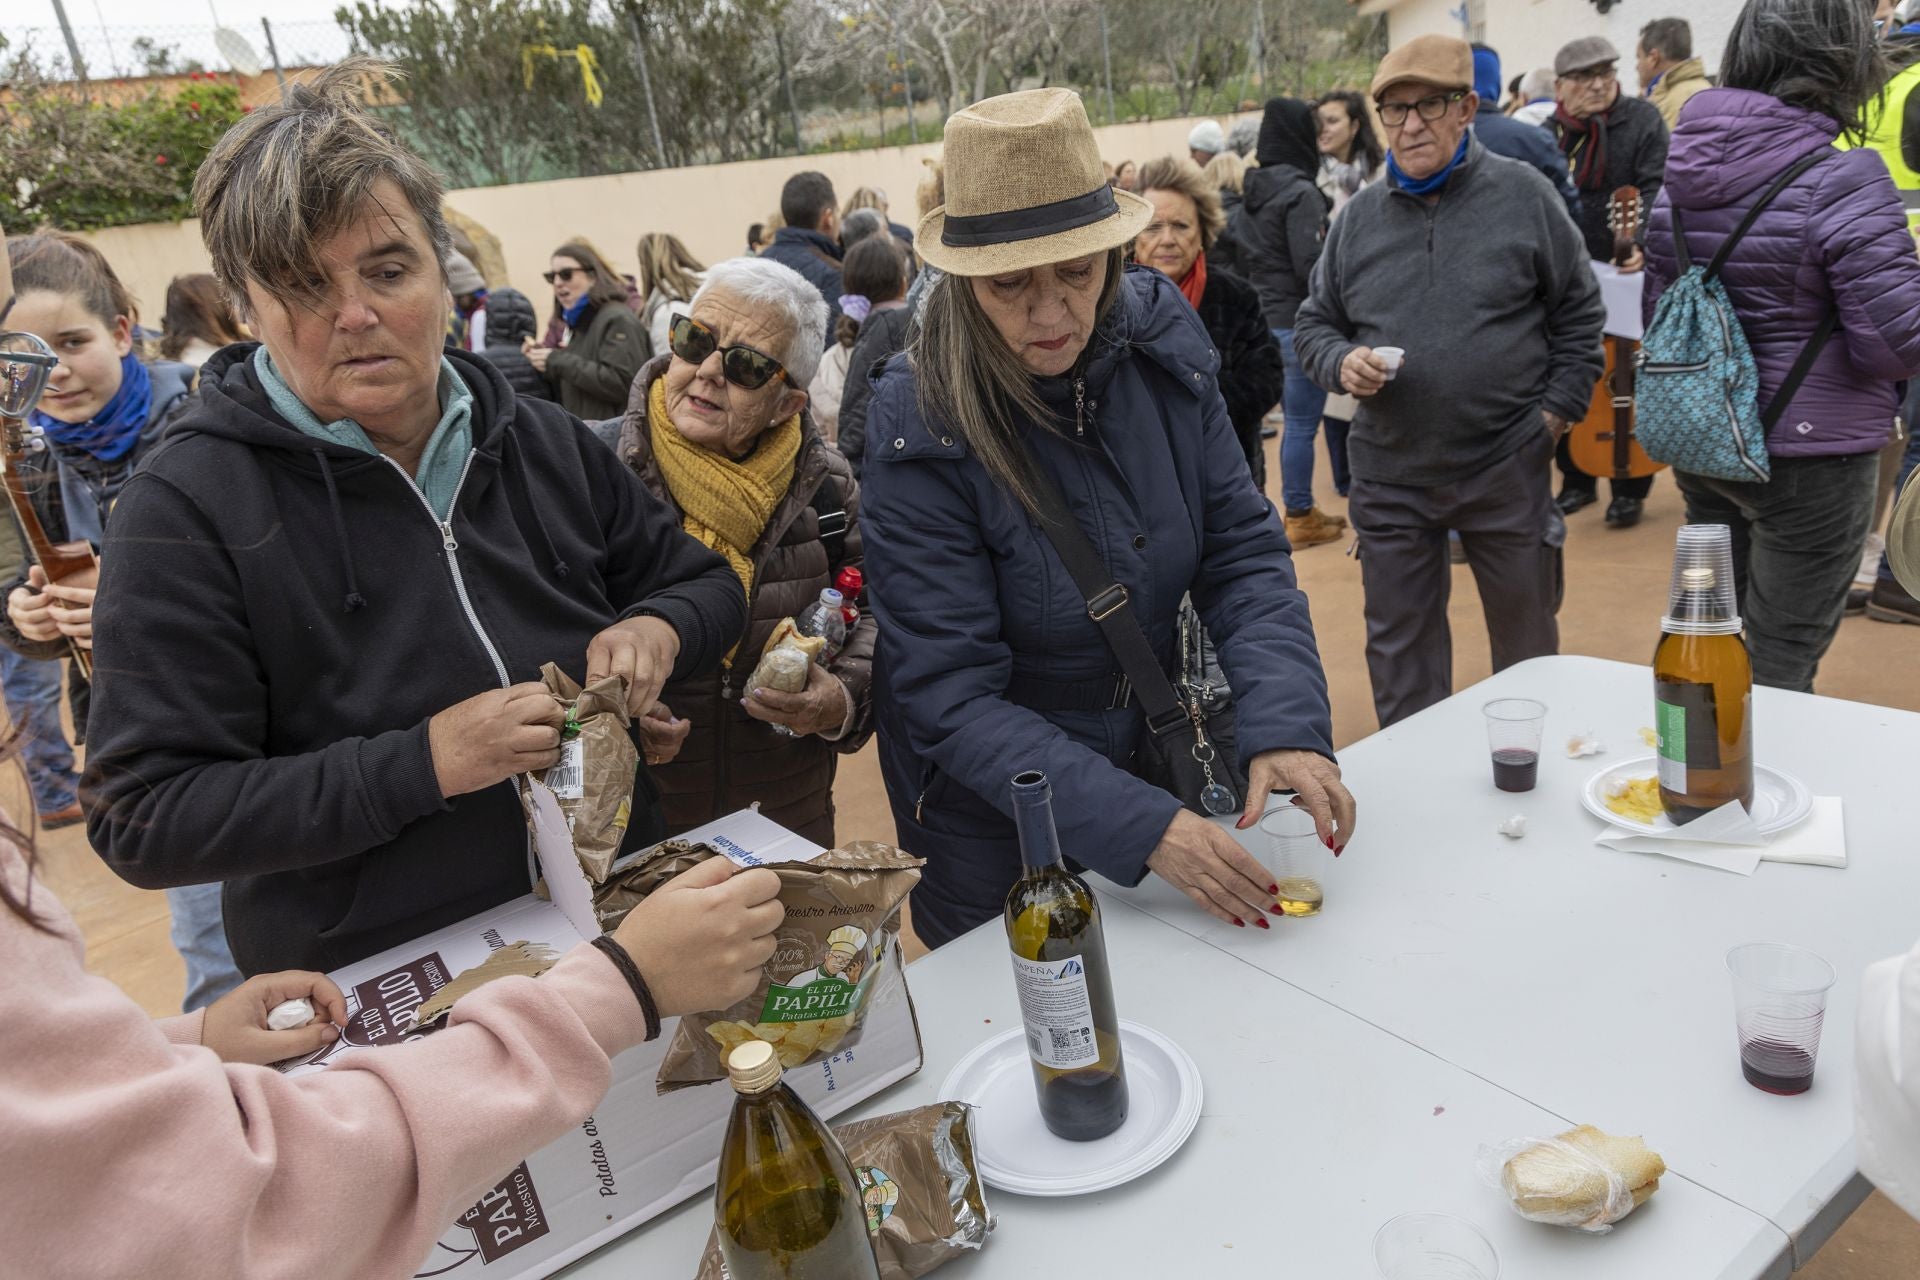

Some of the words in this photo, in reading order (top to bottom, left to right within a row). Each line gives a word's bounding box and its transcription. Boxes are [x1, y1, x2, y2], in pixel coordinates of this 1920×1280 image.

[828, 903, 875, 917] Artesano
[773, 949, 805, 963] 100%
[774, 961, 805, 972] Natural
[806, 986, 820, 994] EL
[823, 984, 842, 993] TÍO
[772, 988, 862, 1011] PAPILIO
[357, 1007, 383, 1026] TÍO
[781, 1011, 818, 1020] Patatas
[820, 1008, 849, 1017] Fritas
[367, 1025, 387, 1040] EL
[582, 1117, 598, 1137] ar
[590, 1139, 618, 1197] Patatas
[514, 1173, 541, 1230] Maestro
[465, 1208, 480, 1221] E
[481, 1187, 523, 1247] PAP
